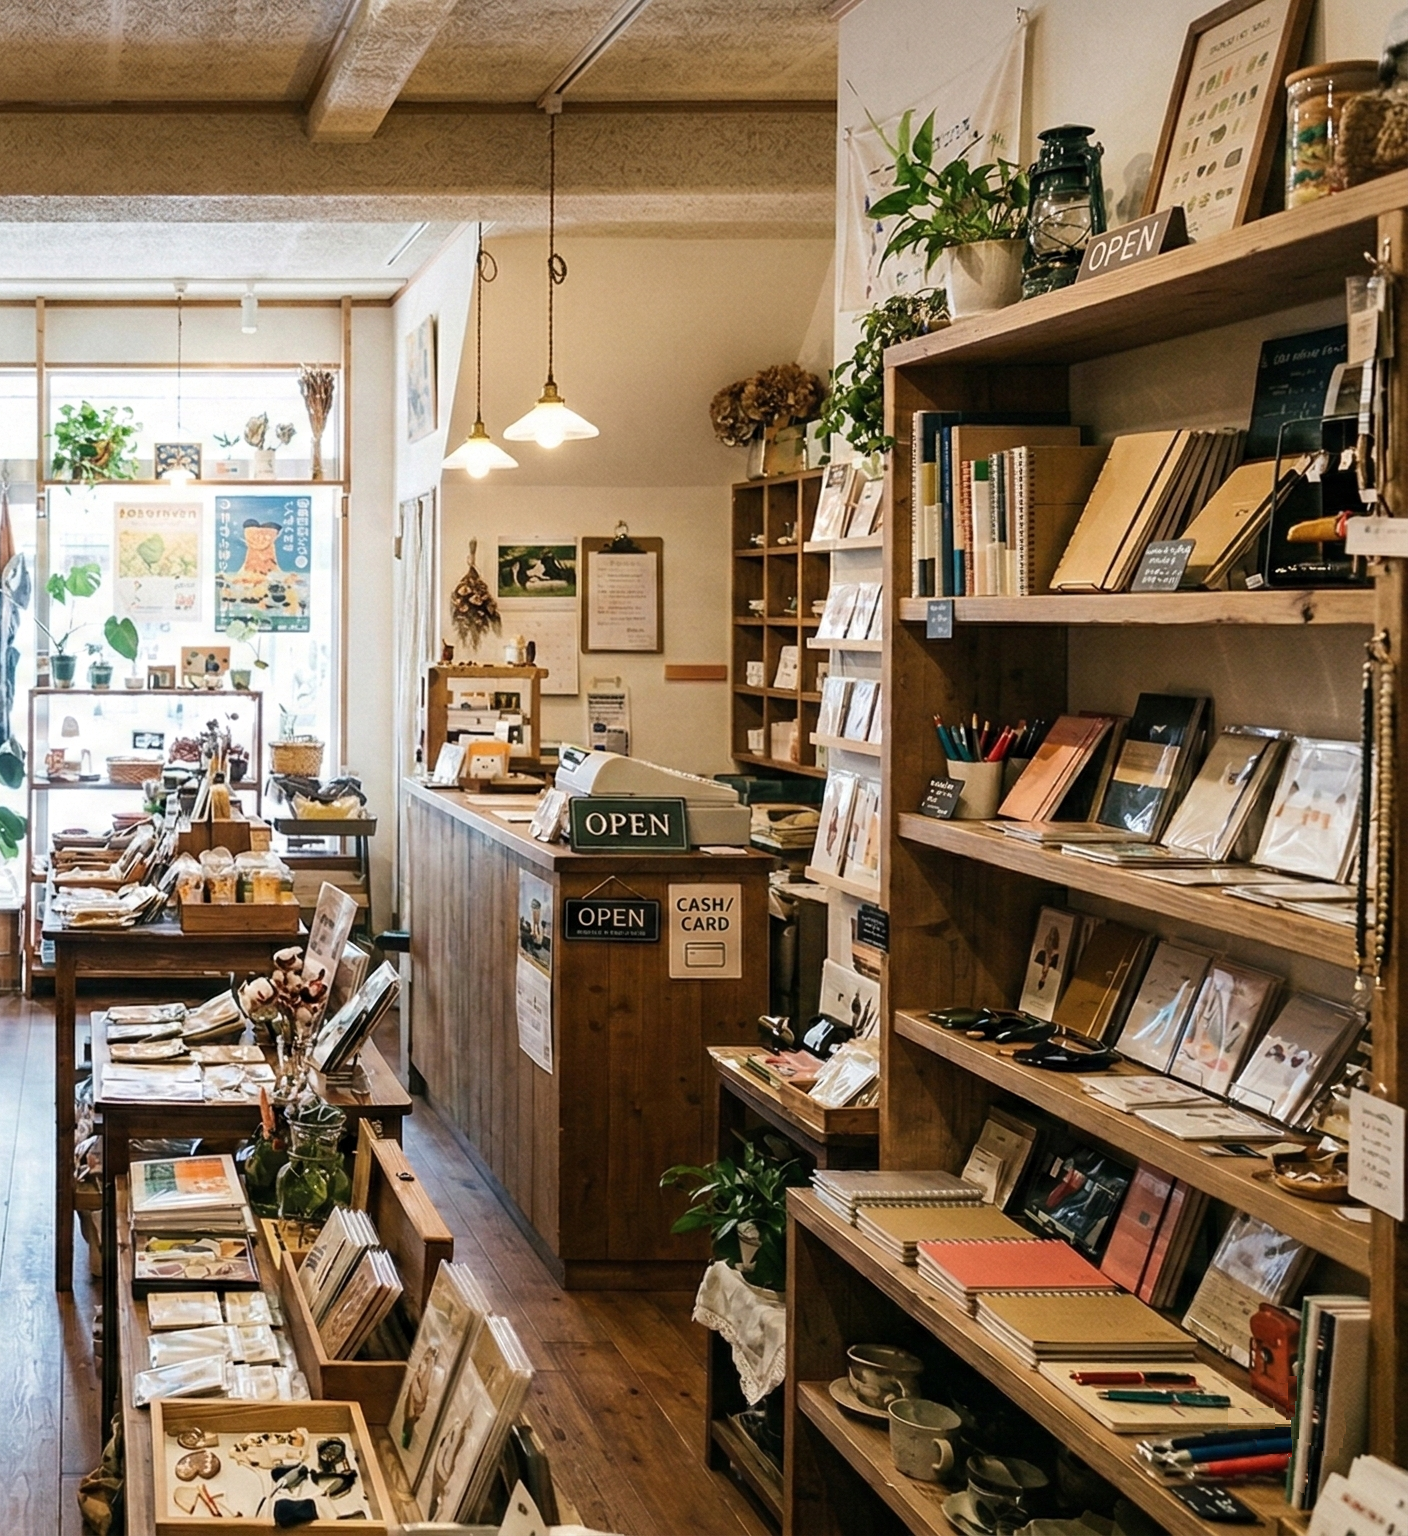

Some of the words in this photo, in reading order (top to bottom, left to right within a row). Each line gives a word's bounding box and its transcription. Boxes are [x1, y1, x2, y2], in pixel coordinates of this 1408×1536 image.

[1088, 221, 1159, 271] OPEN
[585, 812, 670, 837] OPEN
[676, 897, 734, 912] CASH/
[578, 907, 645, 927] OPEN
[681, 916, 730, 931] CARD
